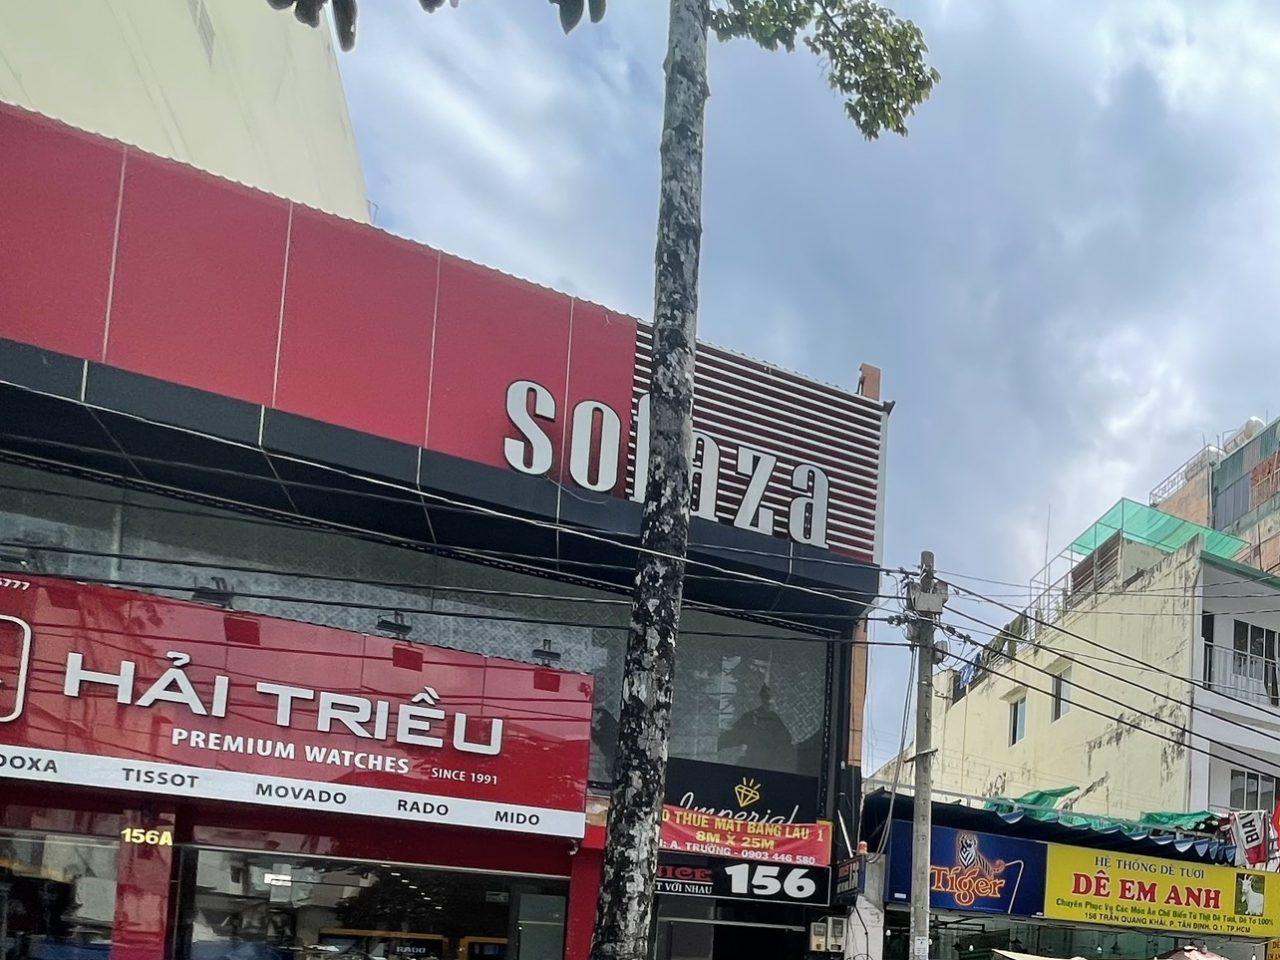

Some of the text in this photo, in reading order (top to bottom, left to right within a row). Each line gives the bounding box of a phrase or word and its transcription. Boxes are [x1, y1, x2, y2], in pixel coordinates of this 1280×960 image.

[63, 651, 503, 755] HẢI TRIỀU
[171, 727, 409, 774] PREMIUM WATCHES
[122, 767, 199, 788] TISSOT
[431, 767, 498, 785] SINCE 1991
[256, 783, 347, 804] MOVADO
[397, 799, 449, 816] RADO
[494, 810, 540, 826] MIDO
[121, 828, 173, 845] 156A
[695, 830, 721, 843] 8M
[740, 837, 775, 850] 25M
[1241, 818, 1260, 845] BIA
[685, 842, 731, 855] TRƯỜNG
[741, 850, 769, 860] 0903
[772, 853, 792, 862] 446
[796, 855, 816, 865] 580
[665, 882, 683, 892] VỚI
[685, 884, 712, 894] NHAU
[724, 863, 816, 899] 156
[930, 865, 1005, 906] Tiger
[1072, 869, 1222, 909] DÊ EM ANH
[1122, 915, 1147, 924] QUANG
